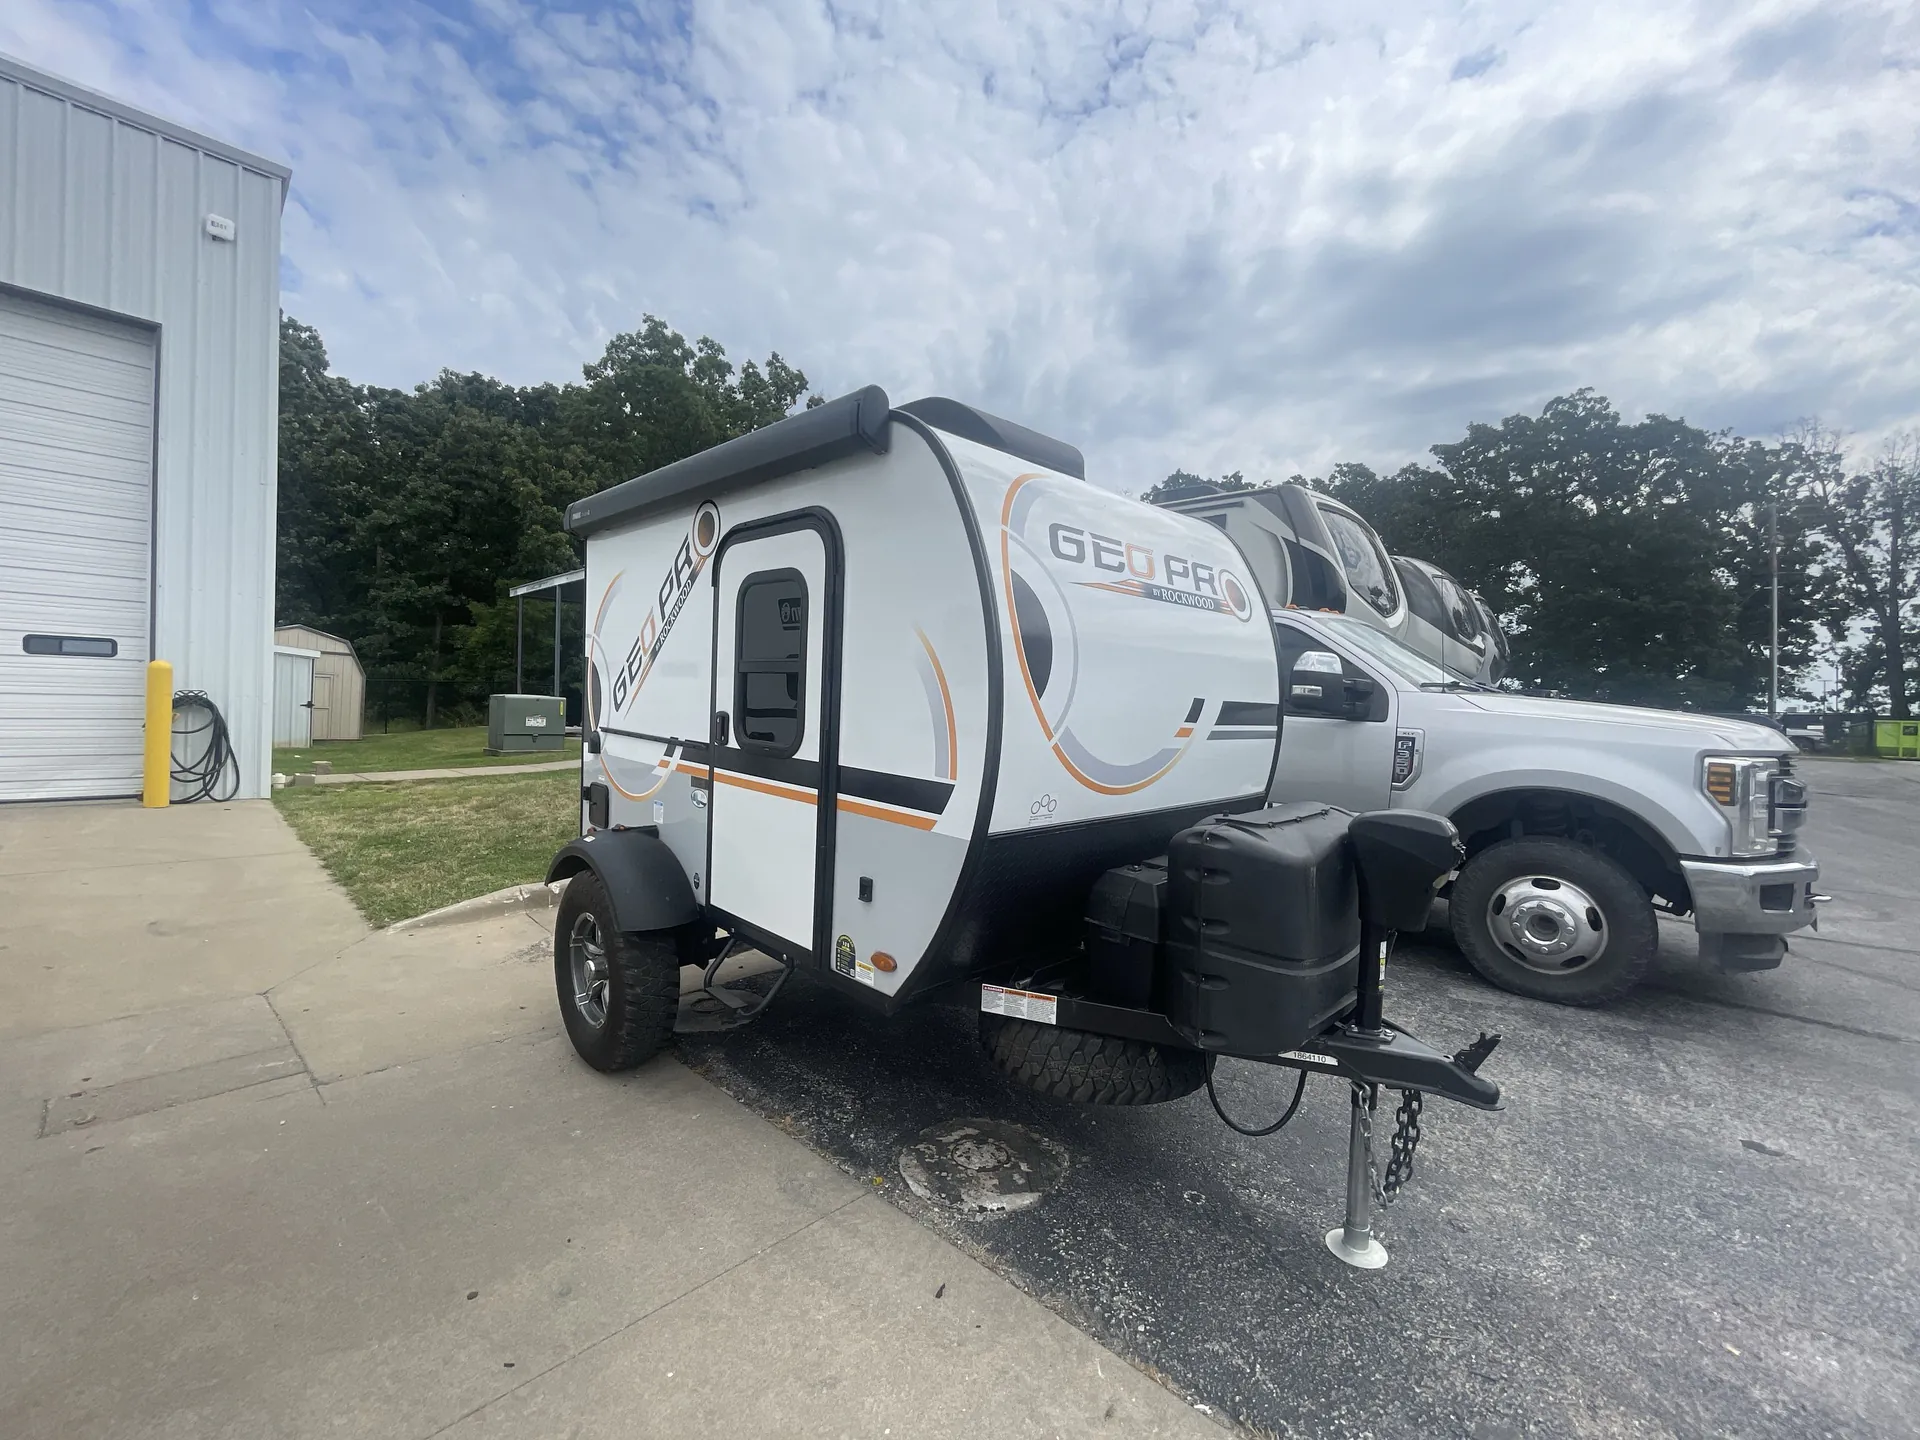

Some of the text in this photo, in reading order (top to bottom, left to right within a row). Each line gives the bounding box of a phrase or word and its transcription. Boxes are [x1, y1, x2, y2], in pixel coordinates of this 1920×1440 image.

[1048, 522, 1252, 622] GEO PRO
[1152, 588, 1214, 610] BY ROCKWOOD
[659, 579, 692, 645] ROCKWOOD
[613, 606, 656, 712] GEO
[1293, 1051, 1327, 1063] 1864110
